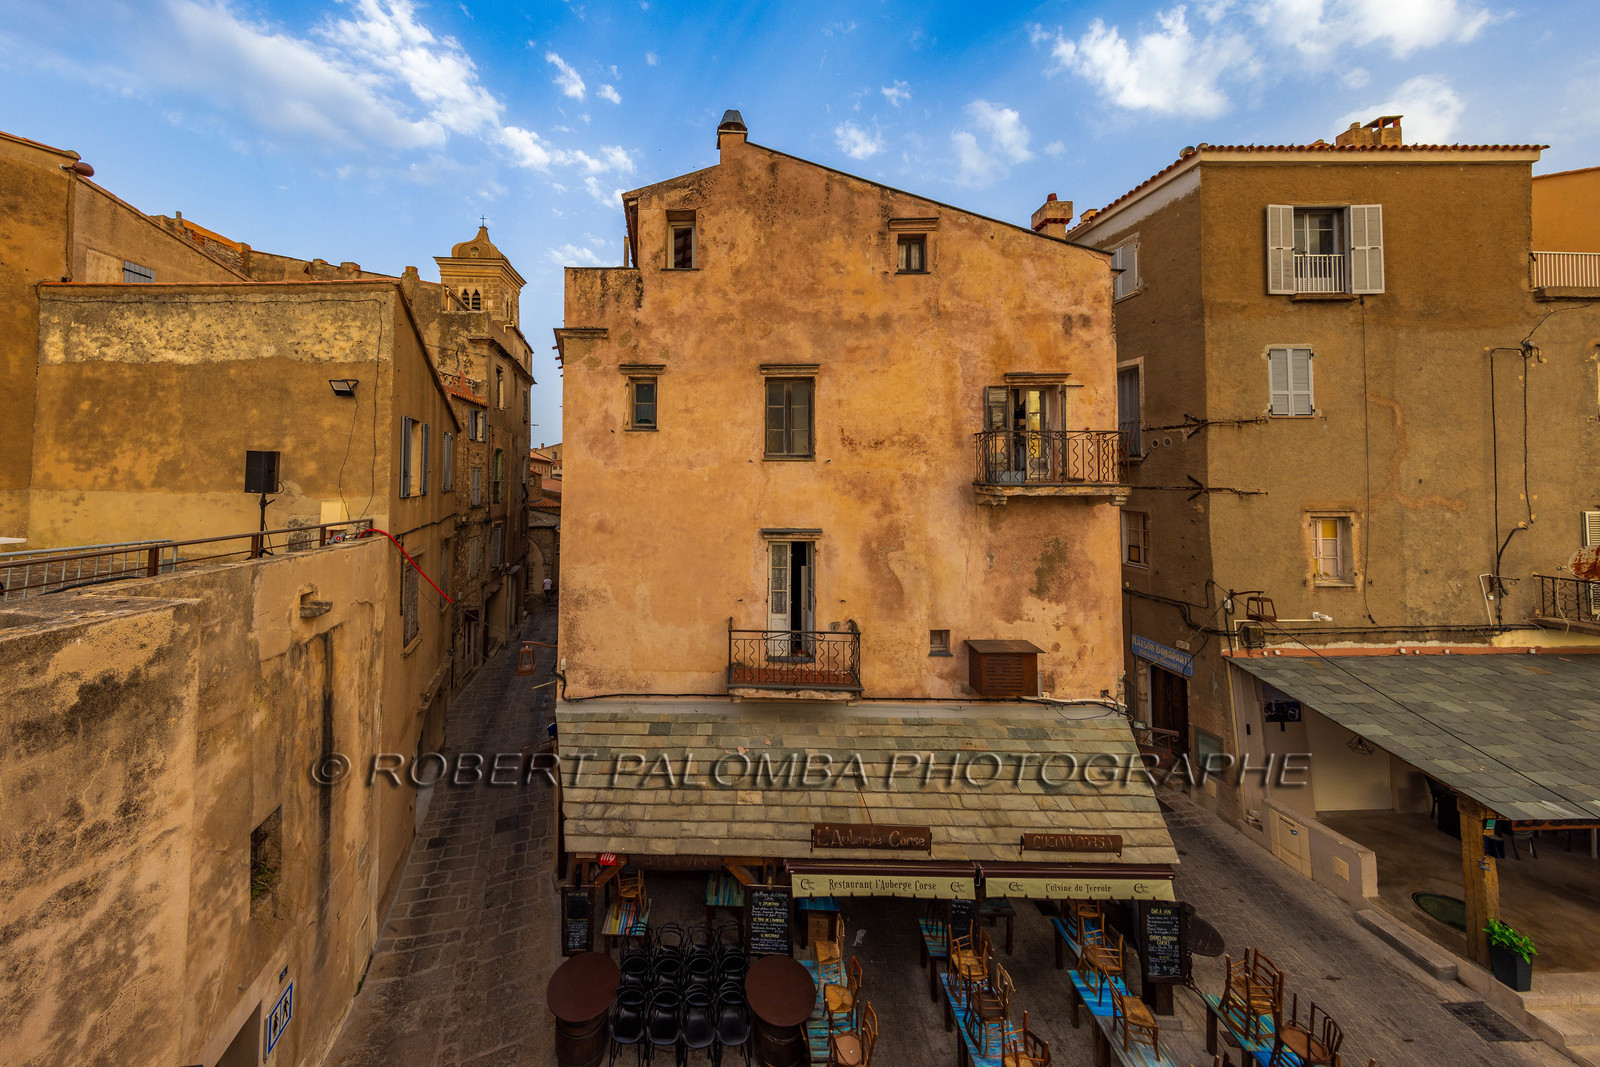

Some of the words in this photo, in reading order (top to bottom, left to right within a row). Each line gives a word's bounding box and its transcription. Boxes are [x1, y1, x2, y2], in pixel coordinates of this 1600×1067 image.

[1132, 636, 1155, 652] MAISON
[1156, 645, 1192, 668] BONAPARTE
[817, 826, 882, 847] L'Auberge
[888, 830, 926, 847] Corse
[600, 852, 615, 863] illy
[828, 878, 873, 890] Restaurant
[875, 878, 912, 892] l'Auberge
[914, 879, 937, 892] Corse
[1045, 882, 1073, 893] Cuisine
[1074, 883, 1083, 893] du
[1086, 883, 1112, 894] Terroir
